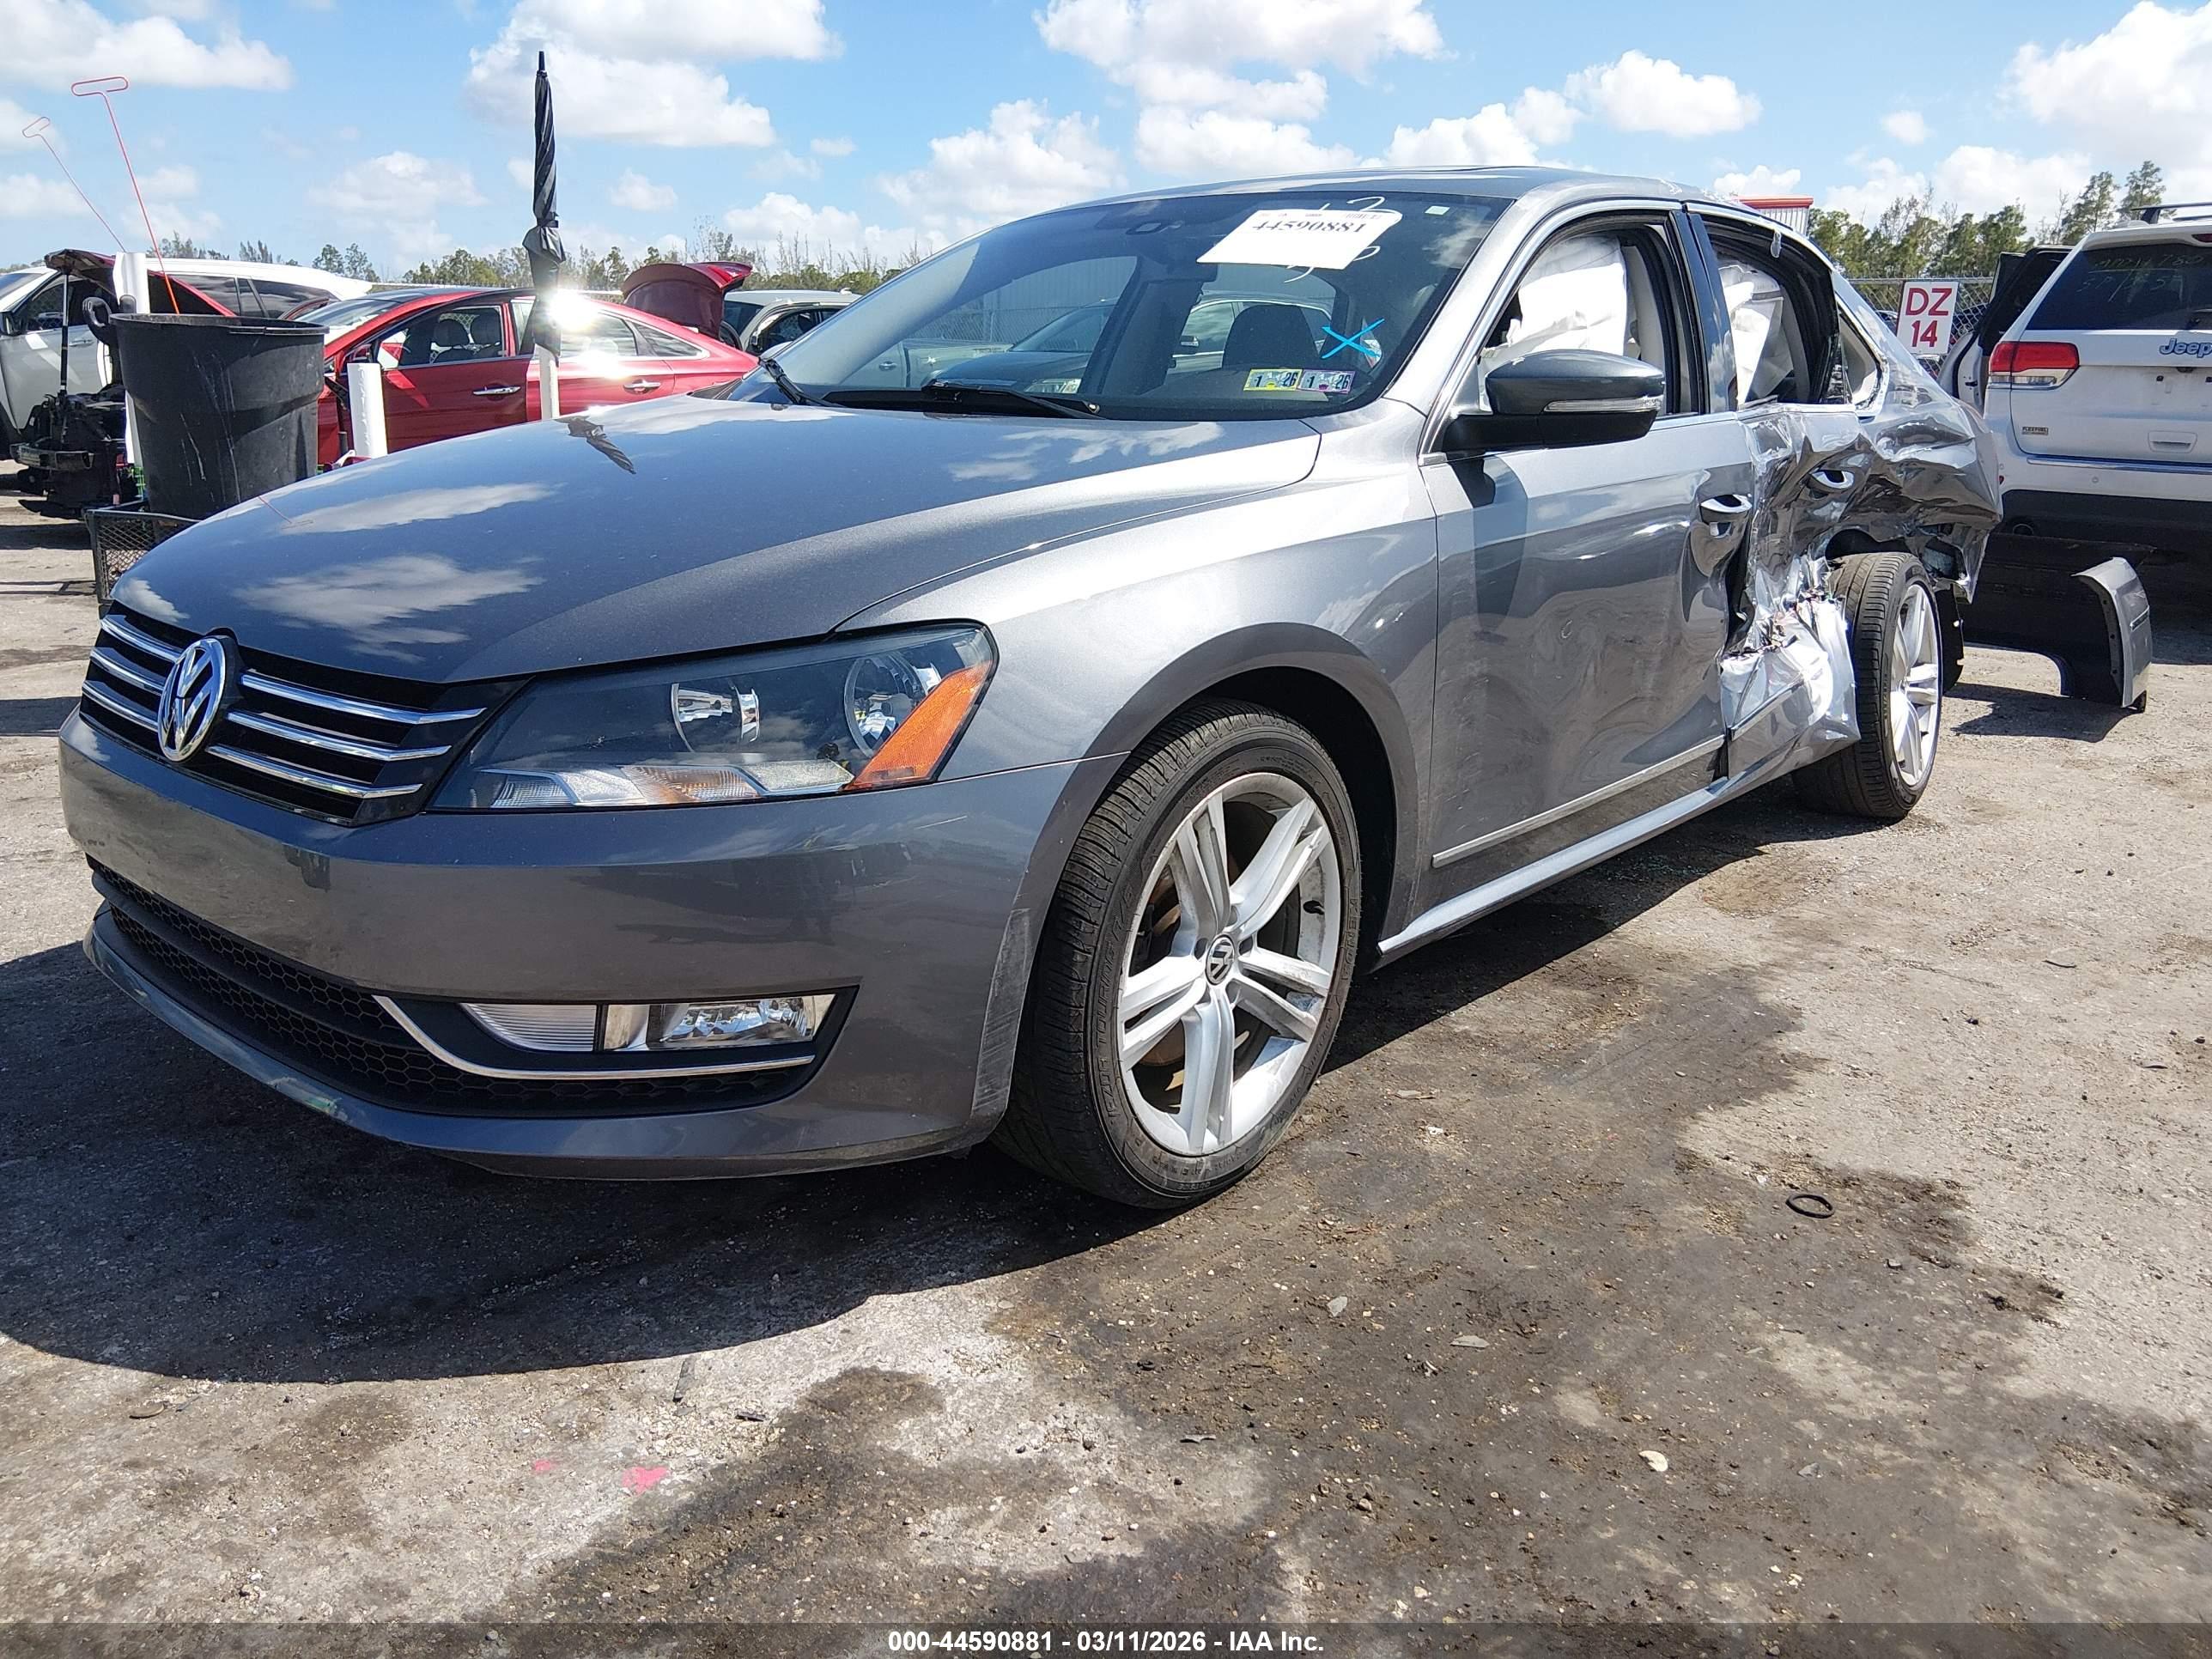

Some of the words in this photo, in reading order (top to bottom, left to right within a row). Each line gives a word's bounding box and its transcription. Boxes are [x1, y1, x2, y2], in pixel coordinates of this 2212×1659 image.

[1253, 220, 1367, 233] 44590881
[1905, 288, 1953, 315] DZ
[1911, 320, 1938, 347] 14
[2159, 337, 2212, 358] Jeep
